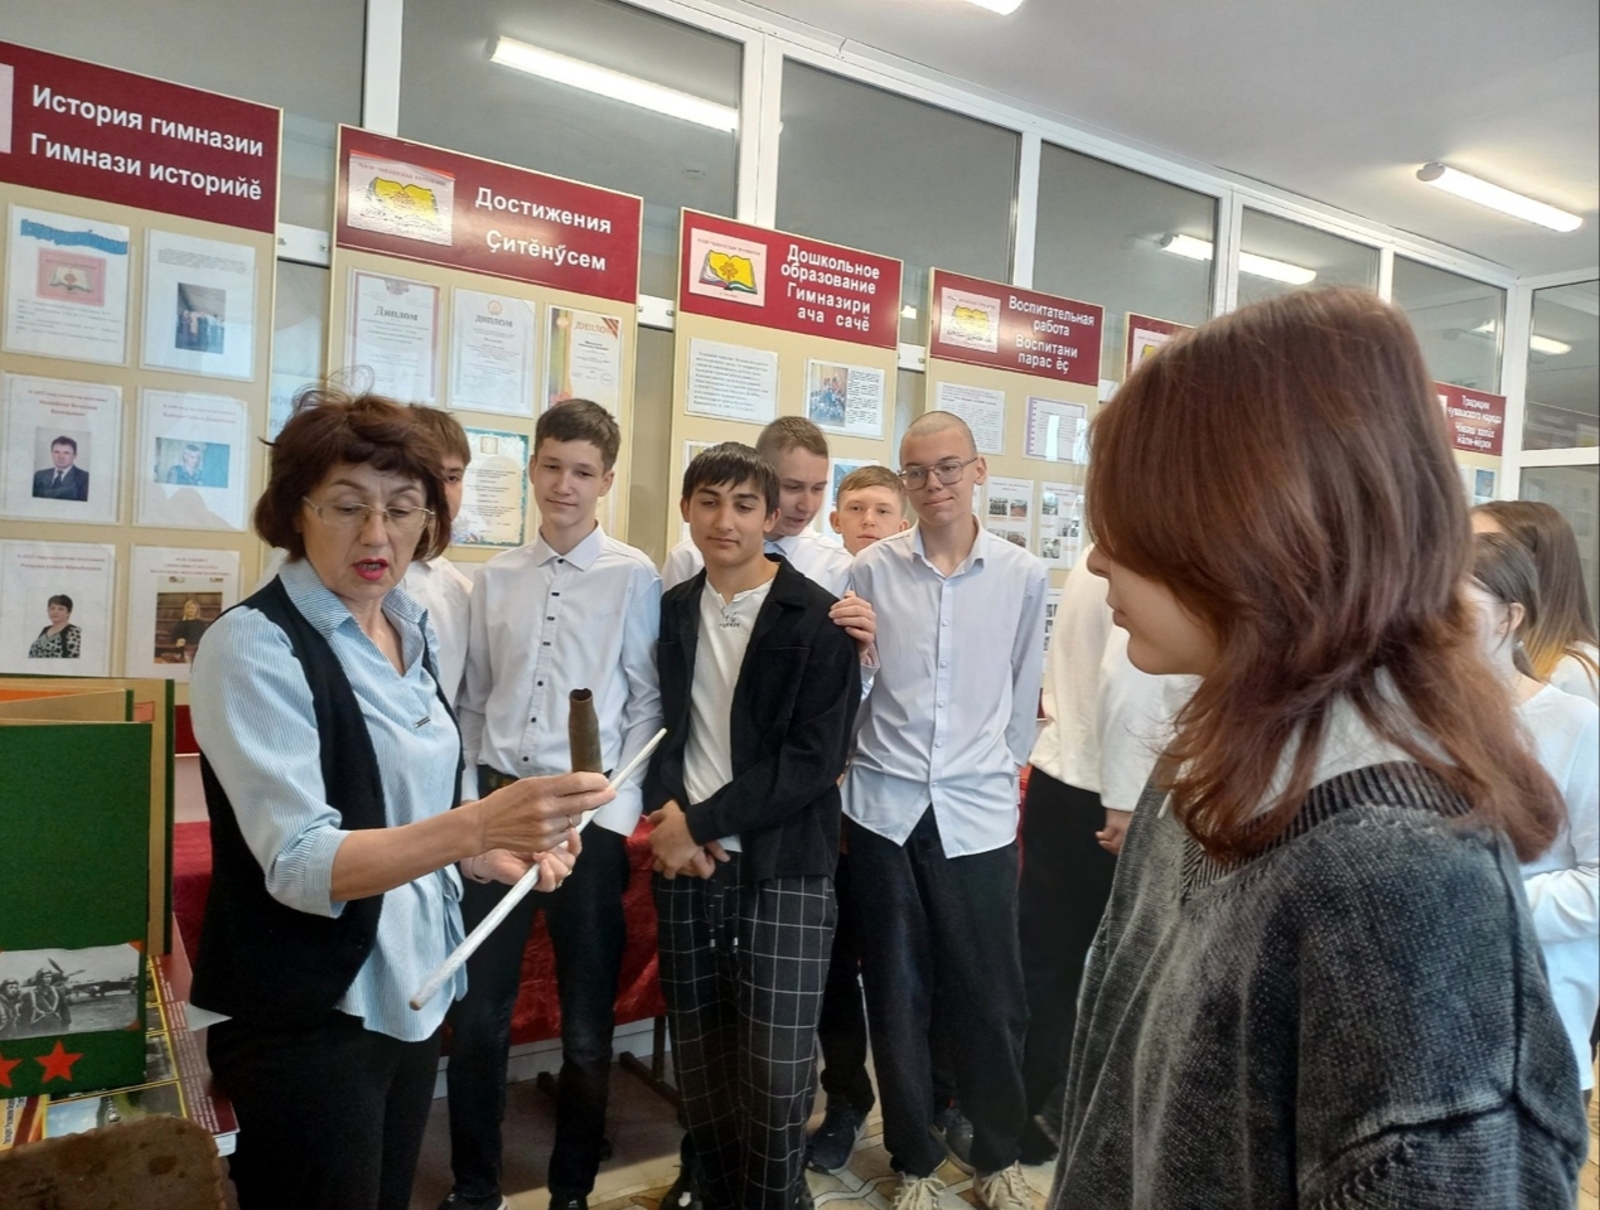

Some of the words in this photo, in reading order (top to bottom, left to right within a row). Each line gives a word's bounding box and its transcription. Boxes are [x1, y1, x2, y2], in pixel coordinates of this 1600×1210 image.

[32, 84, 143, 130] История
[150, 116, 264, 158] гимназии
[30, 132, 142, 177] Гимнази
[474, 186, 612, 234] Достижения
[786, 243, 881, 280] Дошкольное
[780, 262, 877, 296] образование
[373, 305, 418, 322] Диплом
[786, 281, 871, 316] Гимназири
[1008, 295, 1095, 327] Воспитательная
[474, 314, 514, 329] ДИПЛОМ
[797, 307, 825, 324] ача
[1033, 319, 1071, 338] работа
[1015, 334, 1079, 359] Воспитани
[1018, 353, 1053, 370] парас
